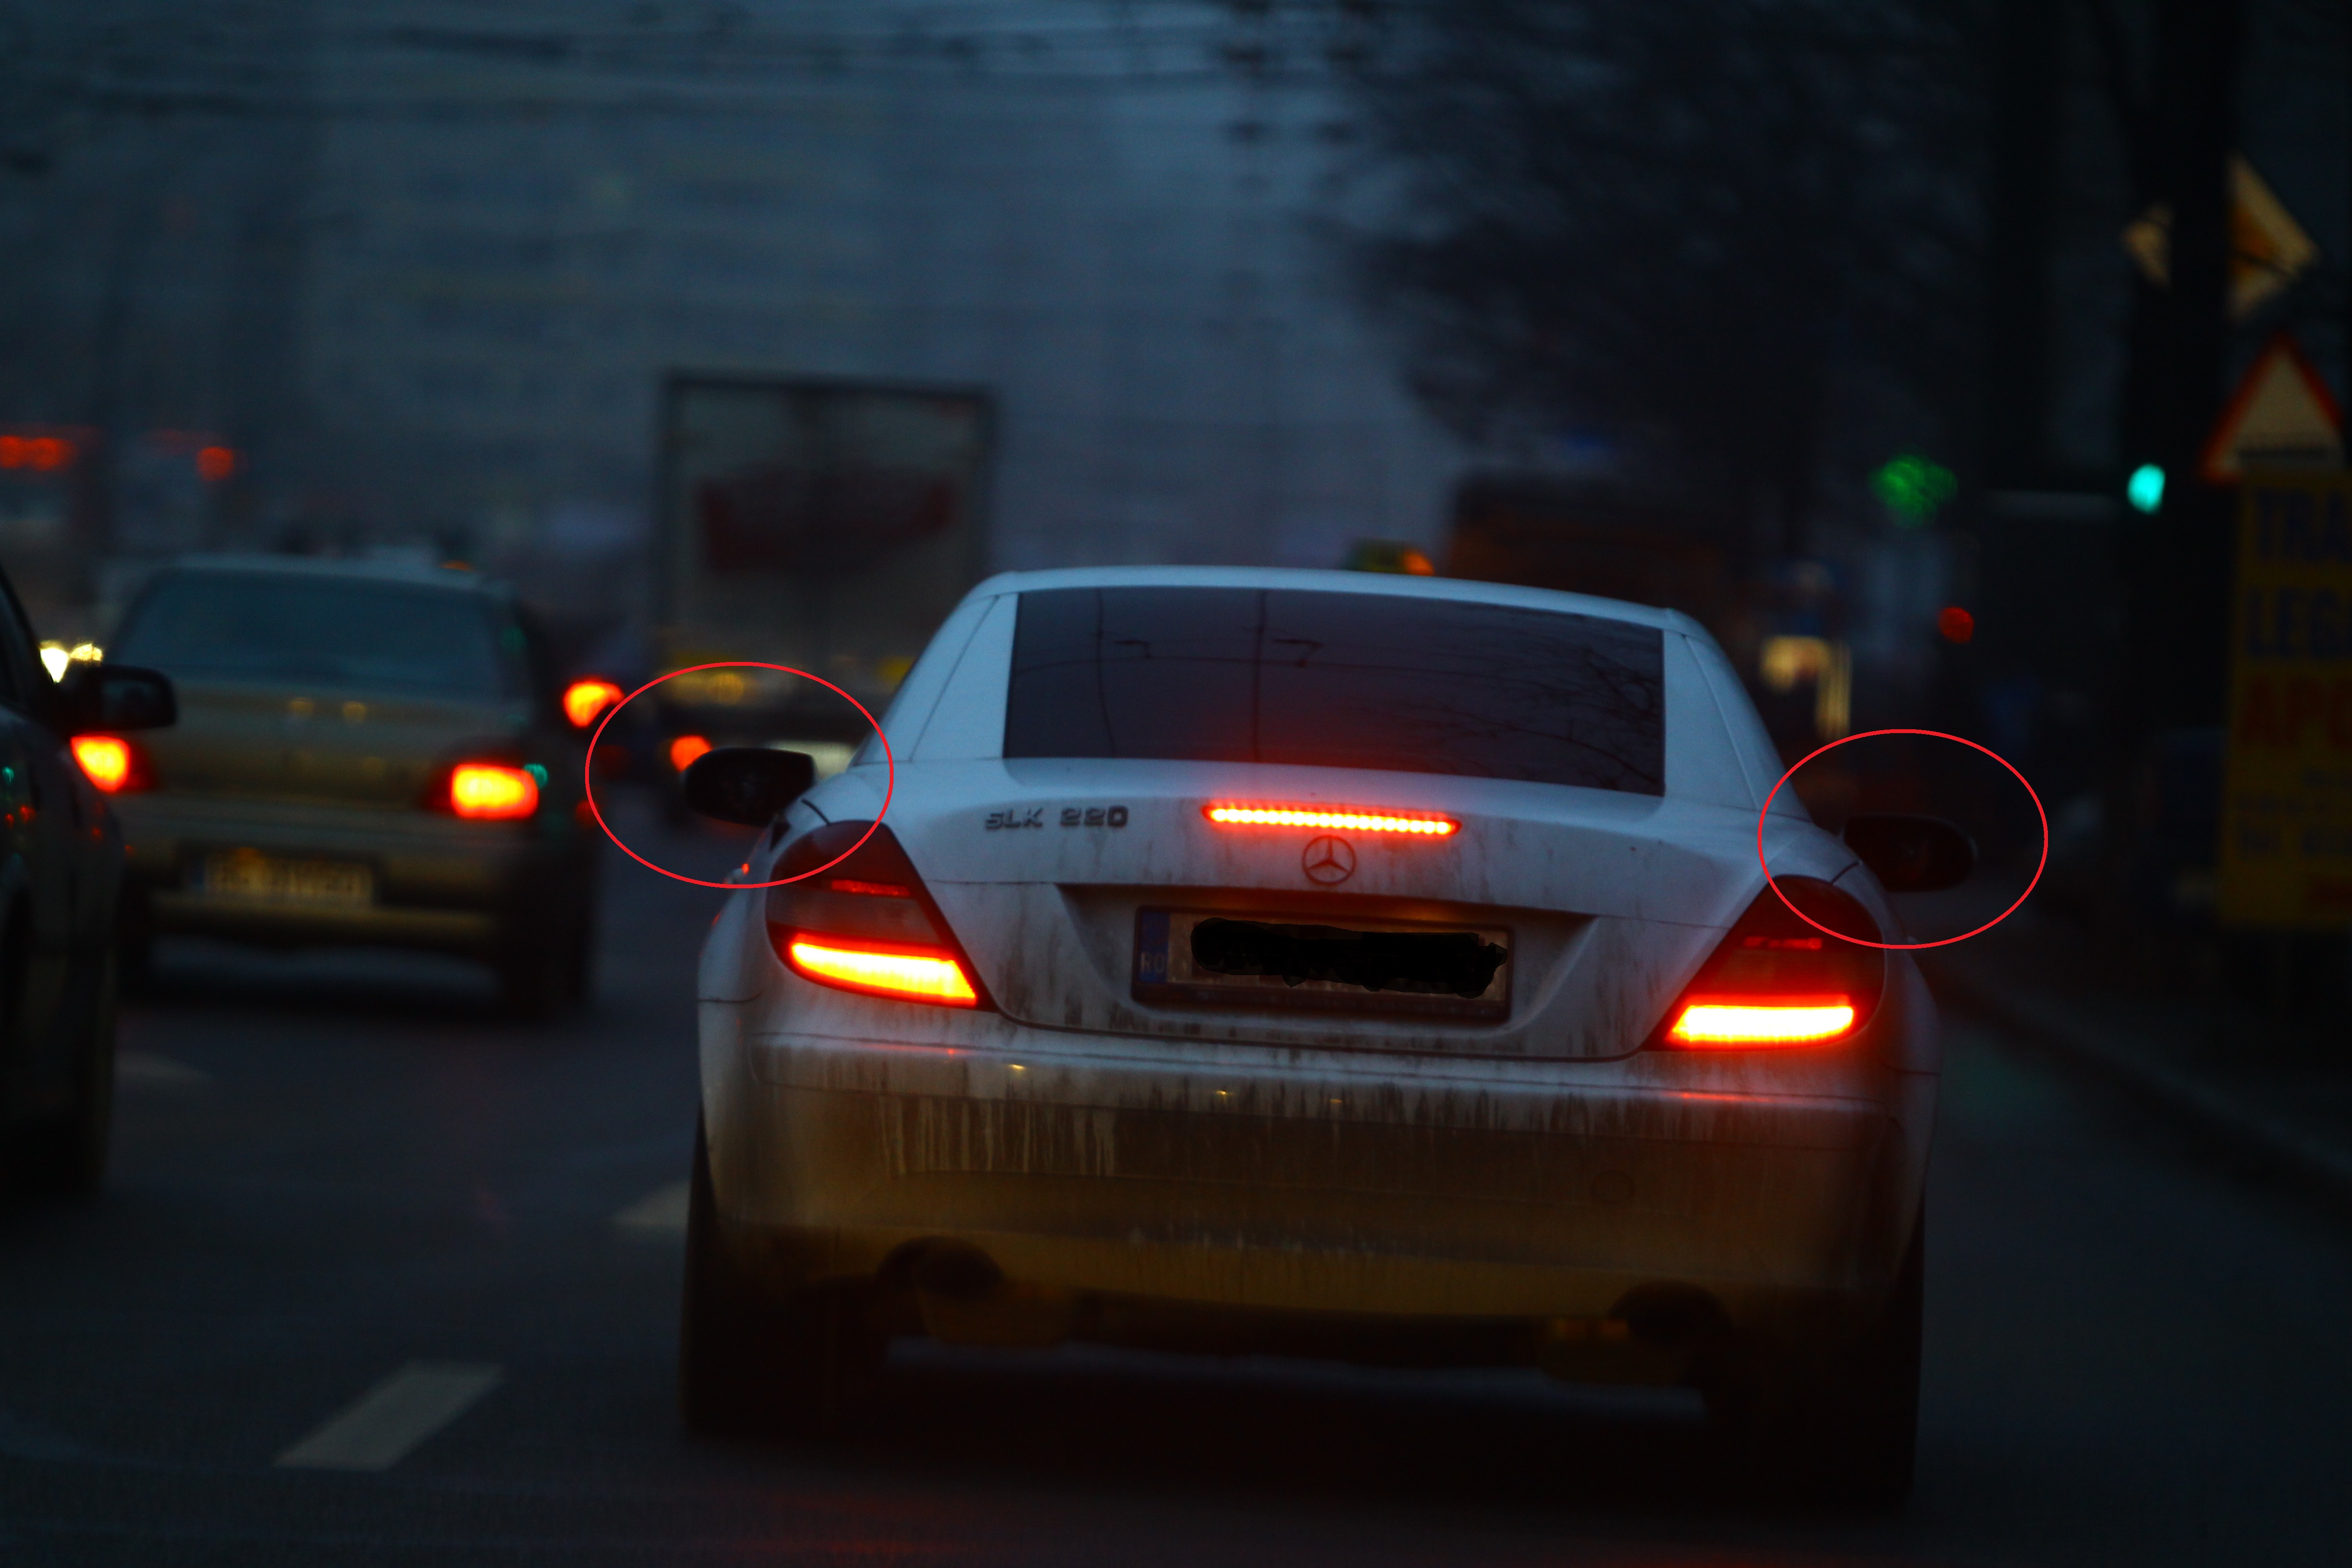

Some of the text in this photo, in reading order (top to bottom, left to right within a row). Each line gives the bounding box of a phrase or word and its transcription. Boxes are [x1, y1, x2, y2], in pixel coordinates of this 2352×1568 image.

[2245, 587, 2352, 658] LEG
[985, 806, 1128, 830] SLK 220
